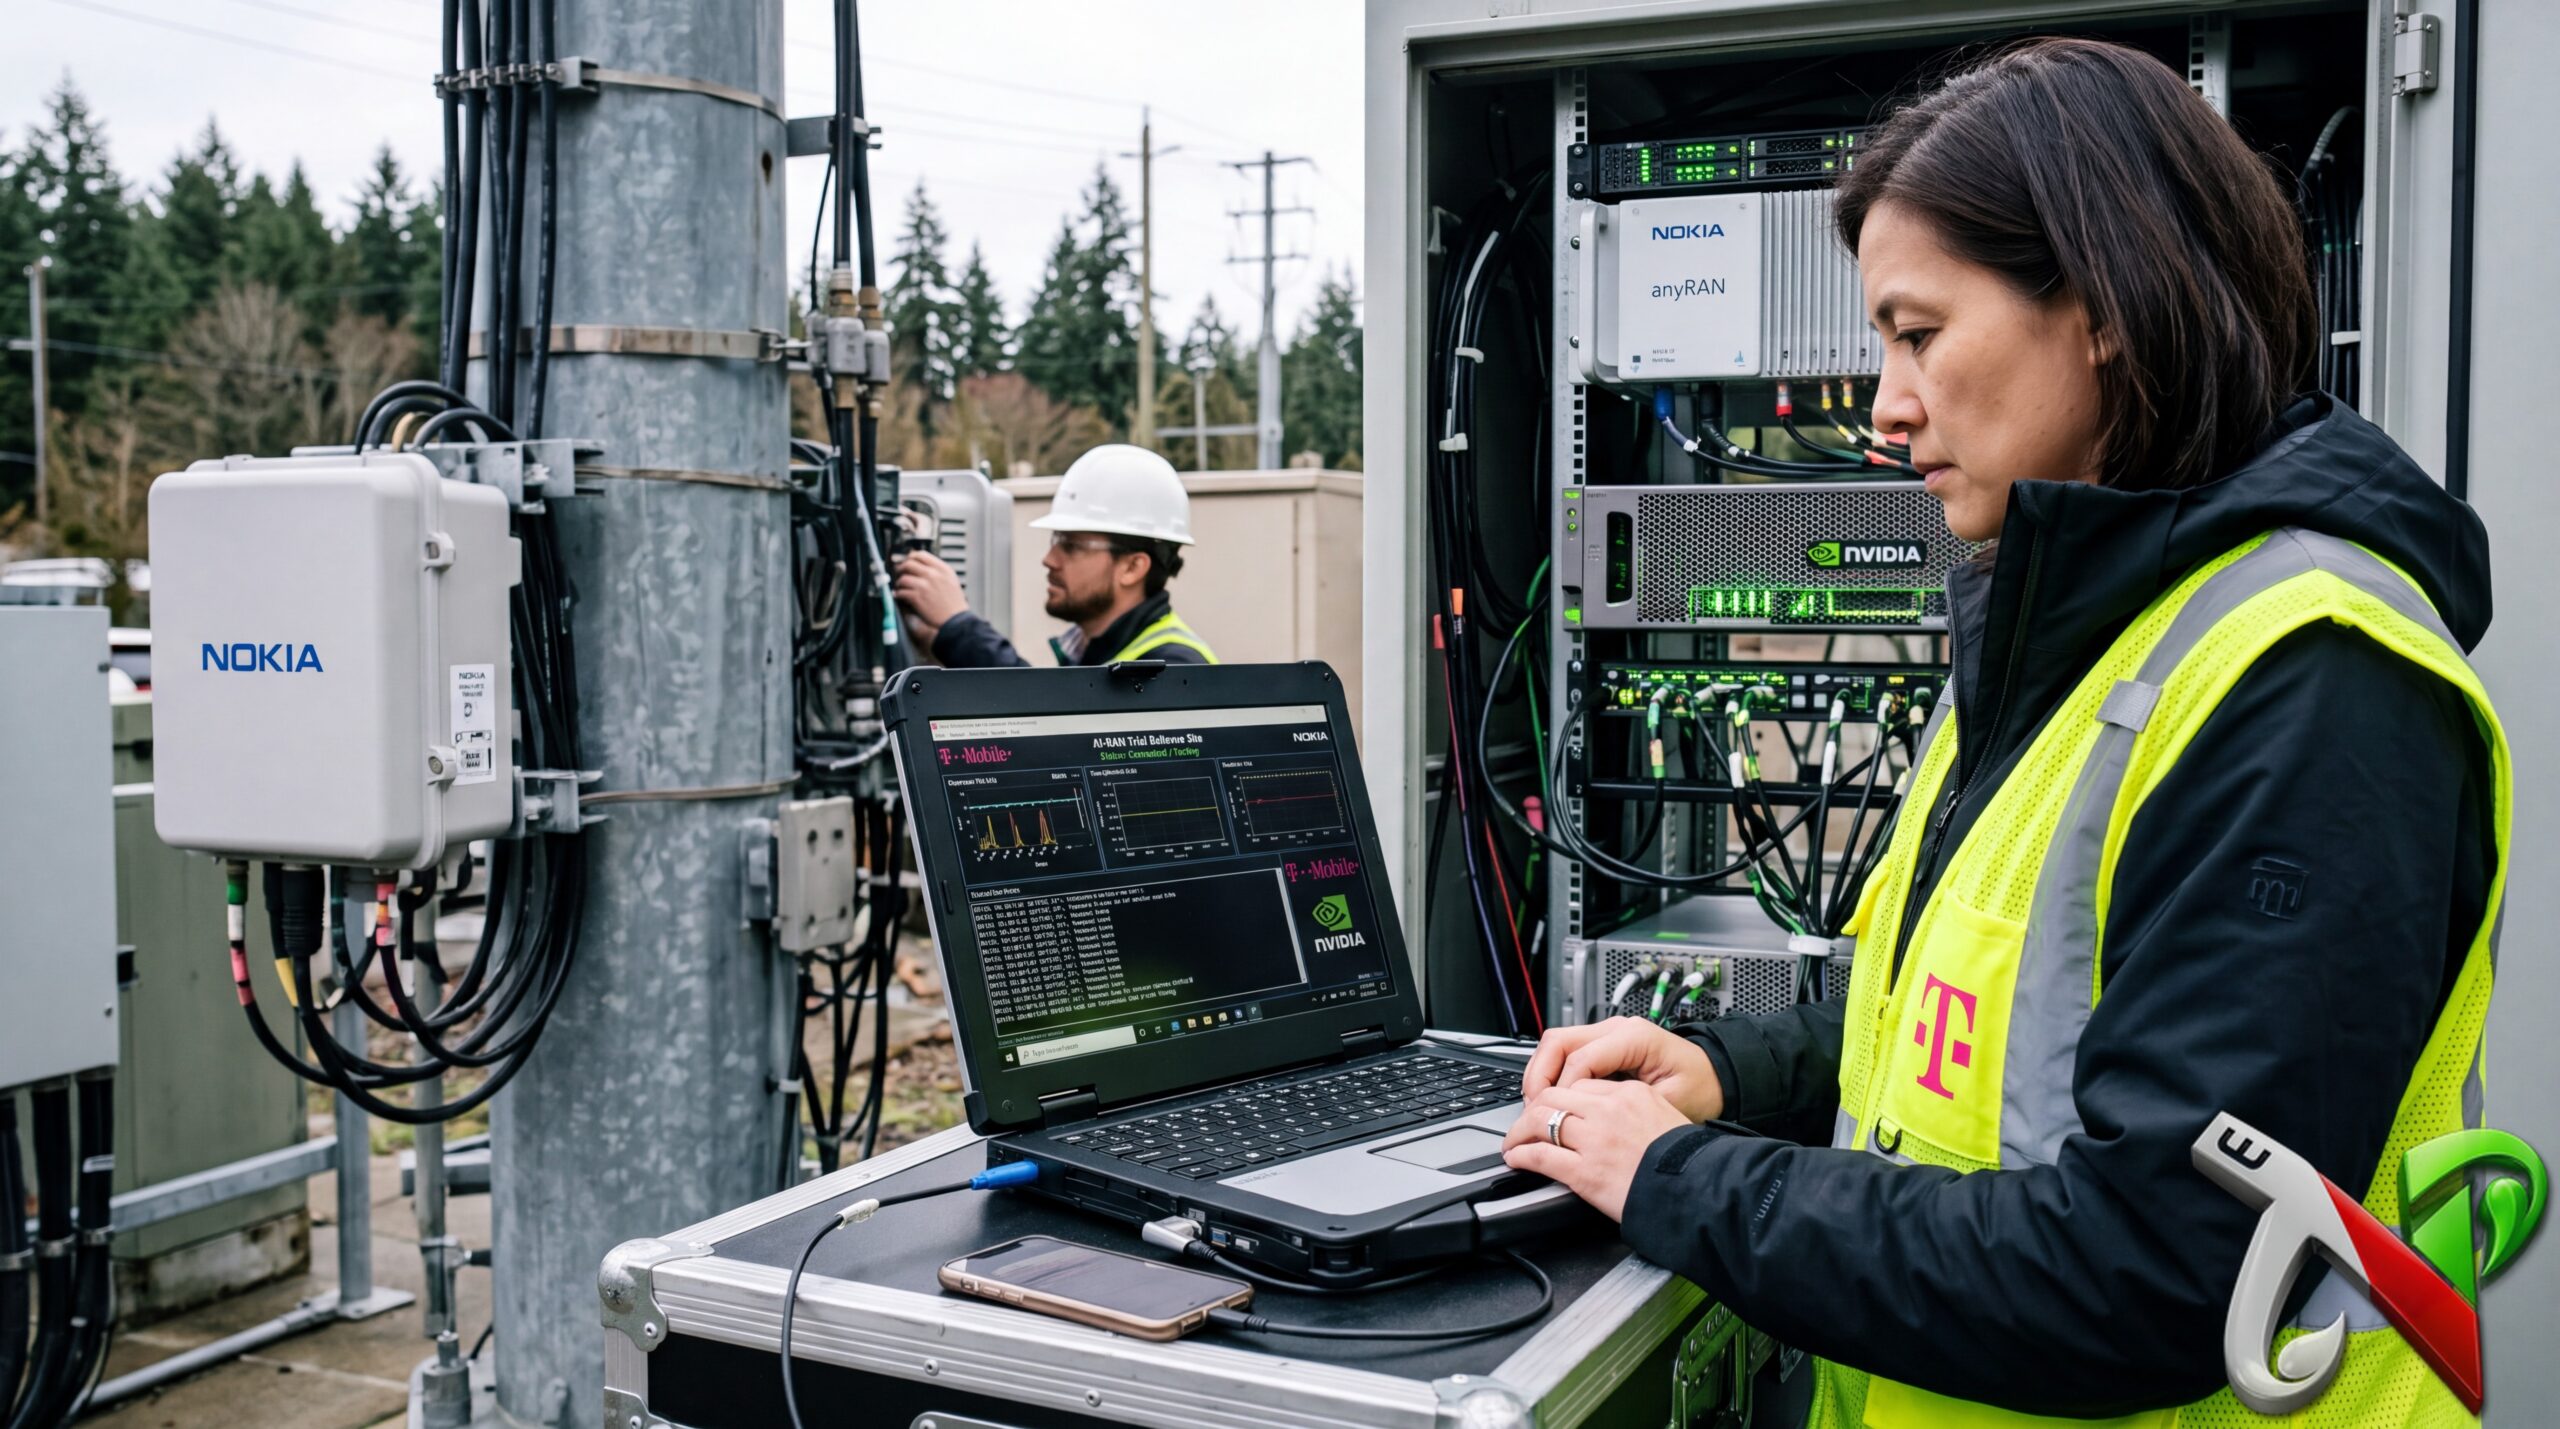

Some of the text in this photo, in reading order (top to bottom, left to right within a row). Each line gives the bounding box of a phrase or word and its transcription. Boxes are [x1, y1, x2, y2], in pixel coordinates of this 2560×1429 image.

[1652, 223, 1725, 241] NOKIA
[1651, 277, 1726, 302] anyRAN
[1844, 545, 1922, 563] NVIDIA
[202, 643, 324, 673] NOKIA
[1292, 731, 1329, 743] NOKIA
[1314, 931, 1367, 953] NVIDIA
